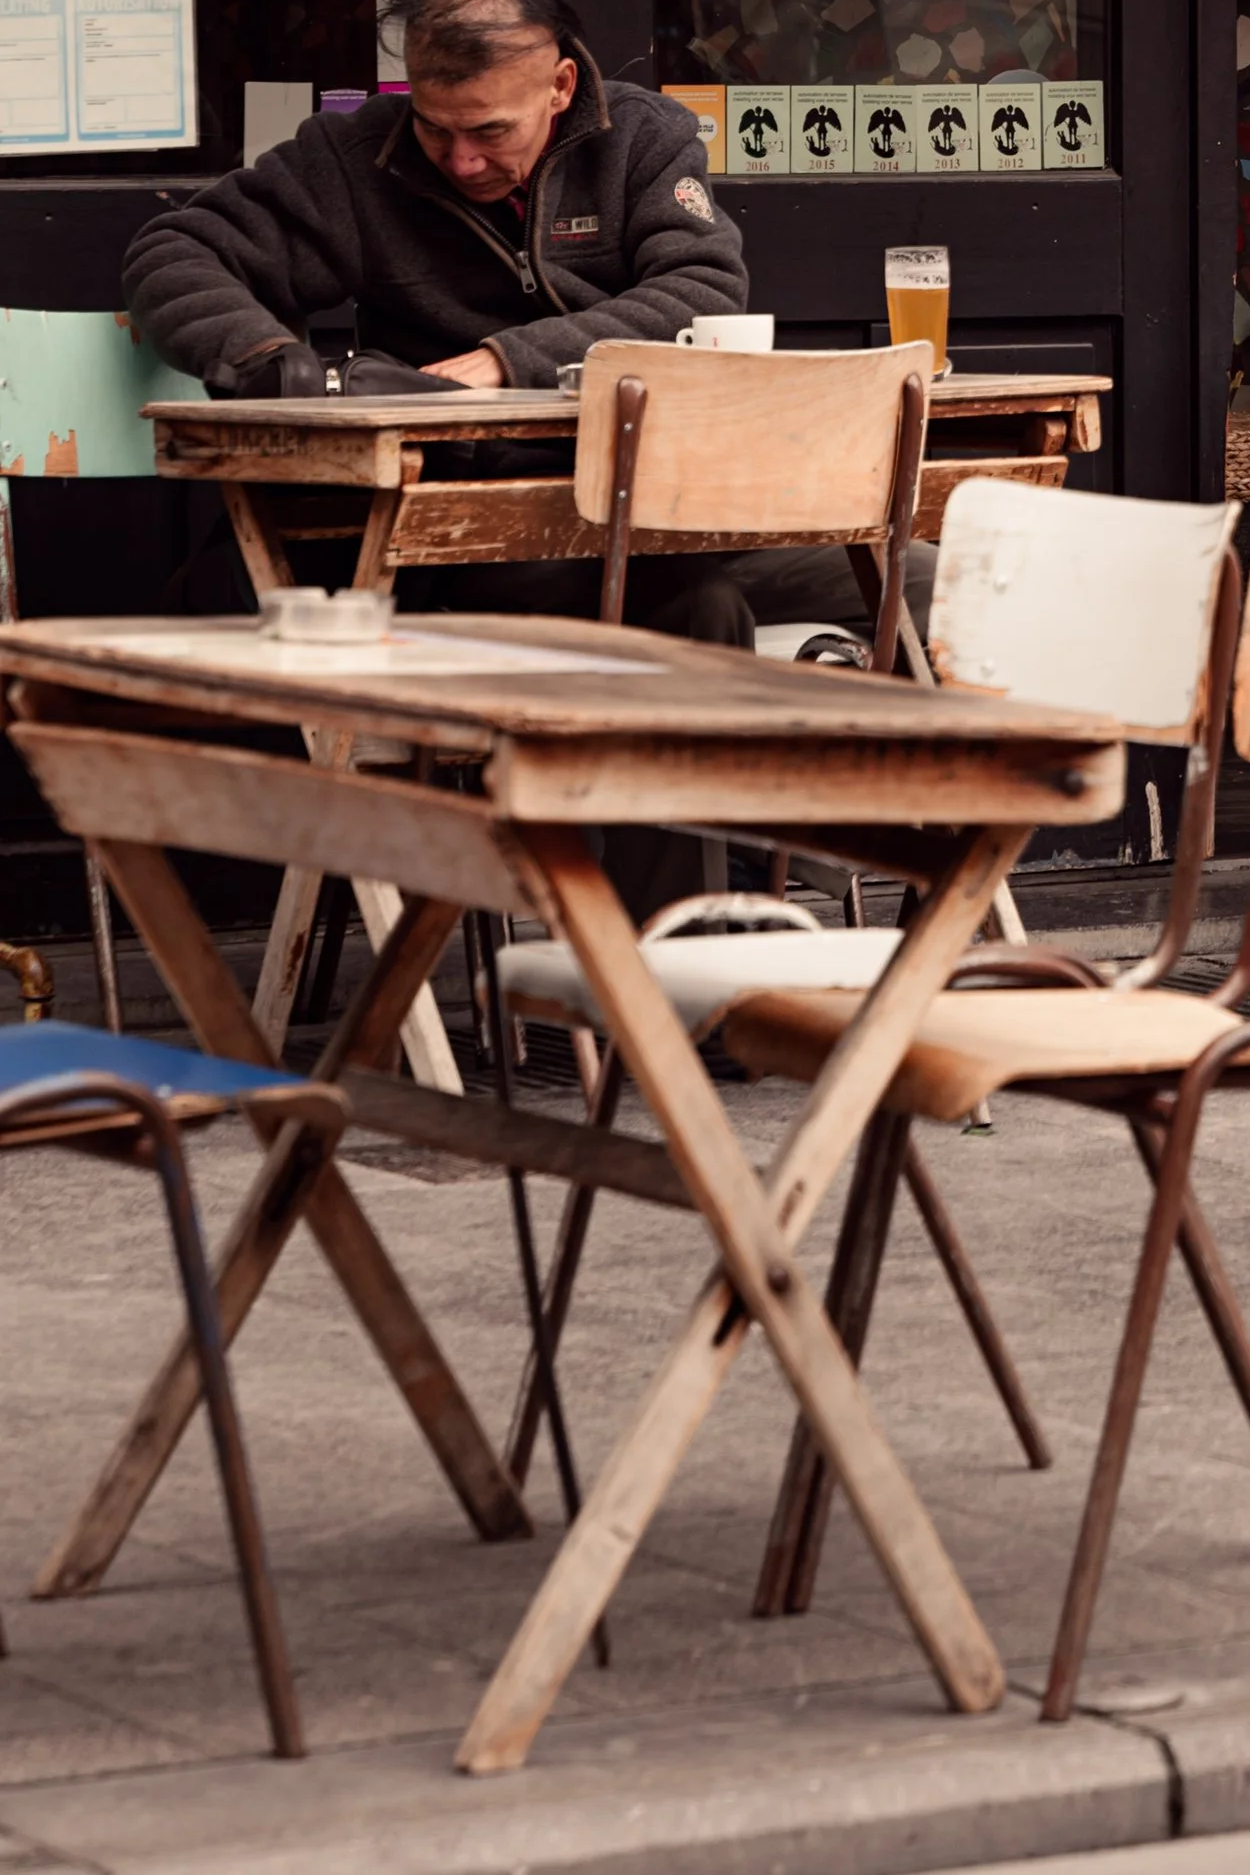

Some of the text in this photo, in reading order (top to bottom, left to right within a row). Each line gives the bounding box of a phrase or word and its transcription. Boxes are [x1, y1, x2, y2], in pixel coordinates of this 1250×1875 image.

[935, 159, 960, 169] 2013
[998, 158, 1024, 168] 2012
[1060, 154, 1086, 164] 2011
[746, 161, 770, 172] 2016
[809, 159, 835, 170] 2015
[872, 161, 899, 172] 2014
